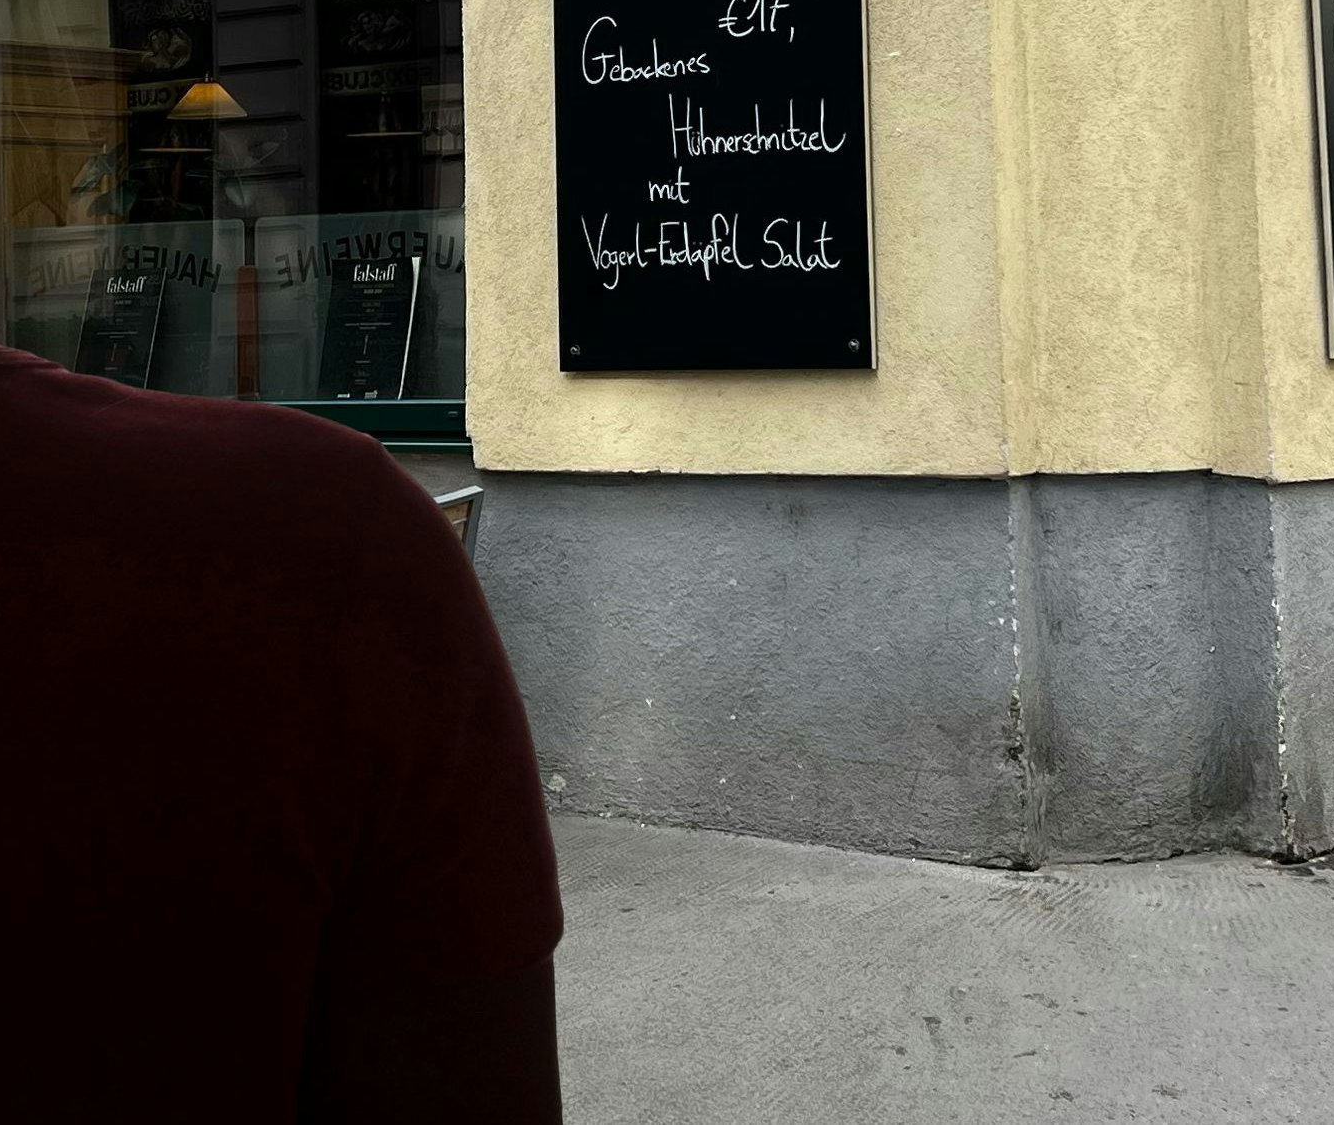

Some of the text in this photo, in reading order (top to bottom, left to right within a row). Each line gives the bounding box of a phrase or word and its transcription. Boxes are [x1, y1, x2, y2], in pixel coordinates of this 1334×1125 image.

[582, 16, 711, 85] Gebackenes
[668, 92, 847, 159] Hühnerschnitzel
[648, 166, 691, 205] mit
[760, 218, 842, 272] Salat
[105, 275, 148, 294] falstaff
[352, 262, 398, 283] falstaff
